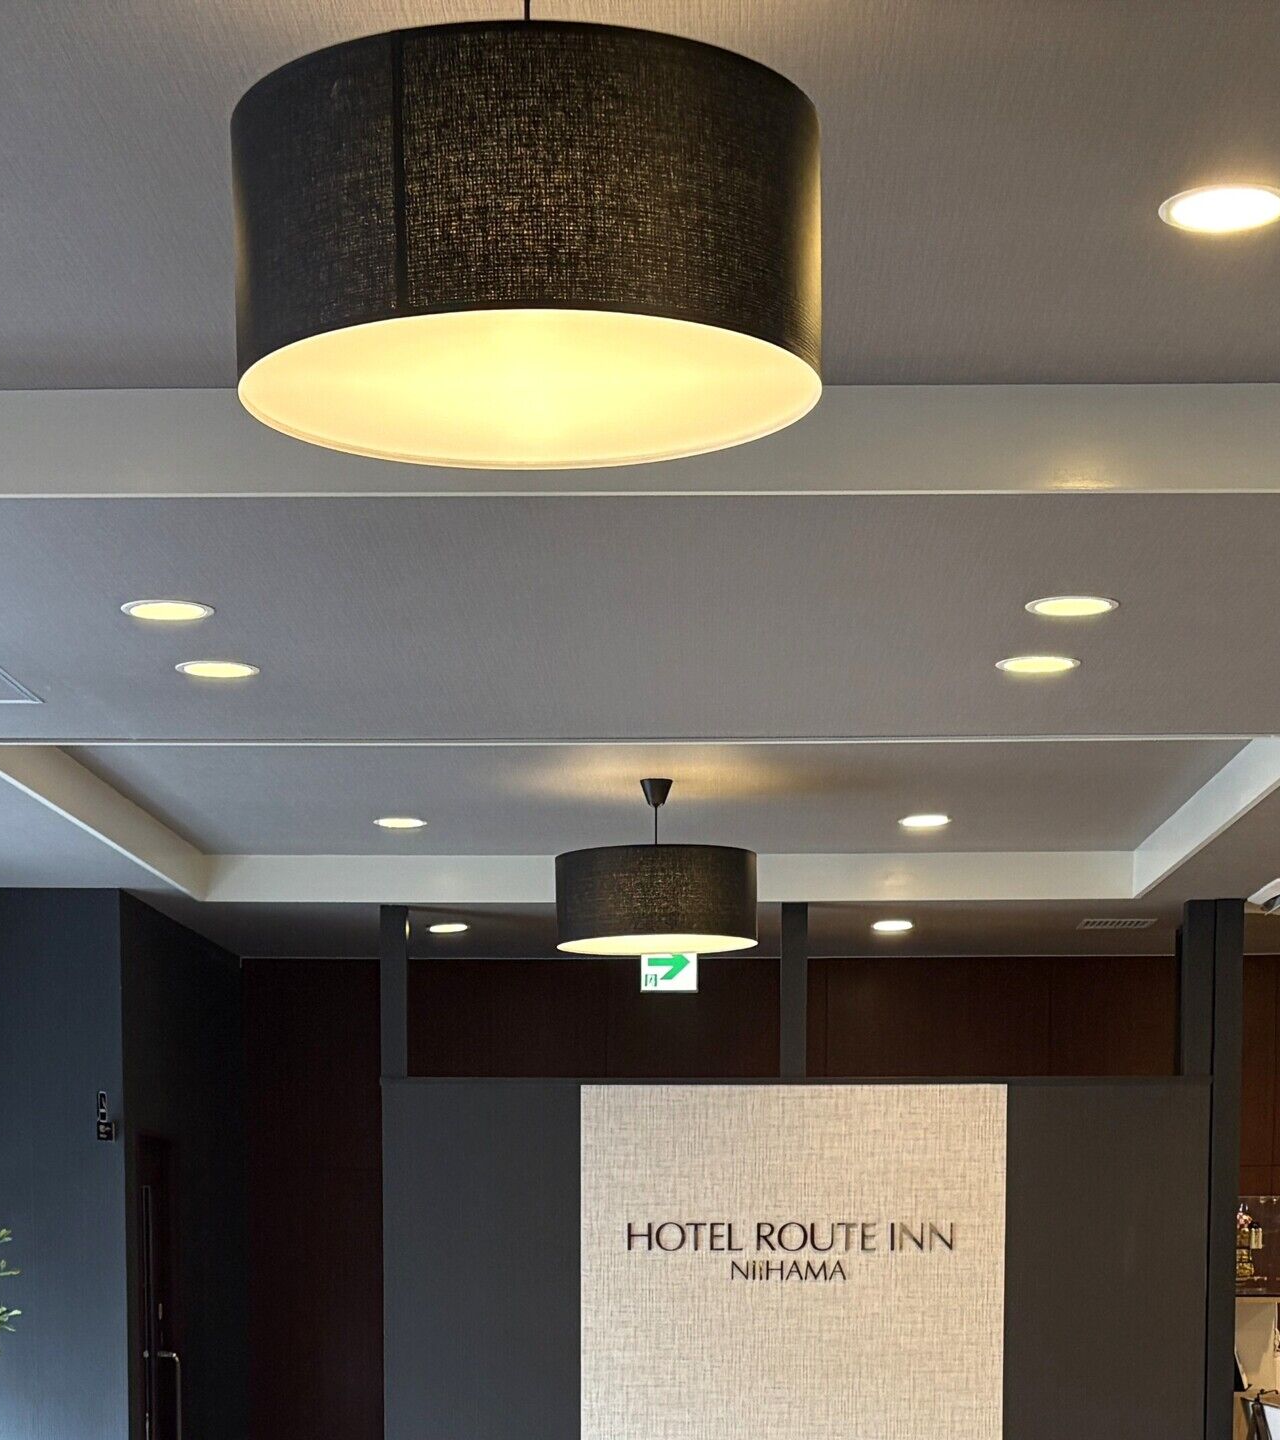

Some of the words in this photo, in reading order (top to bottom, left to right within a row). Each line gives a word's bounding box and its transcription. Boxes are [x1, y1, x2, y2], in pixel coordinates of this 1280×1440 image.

[627, 1222, 743, 1251] HOTEL
[757, 1222, 876, 1251] ROUTE
[890, 1222, 953, 1251] INN
